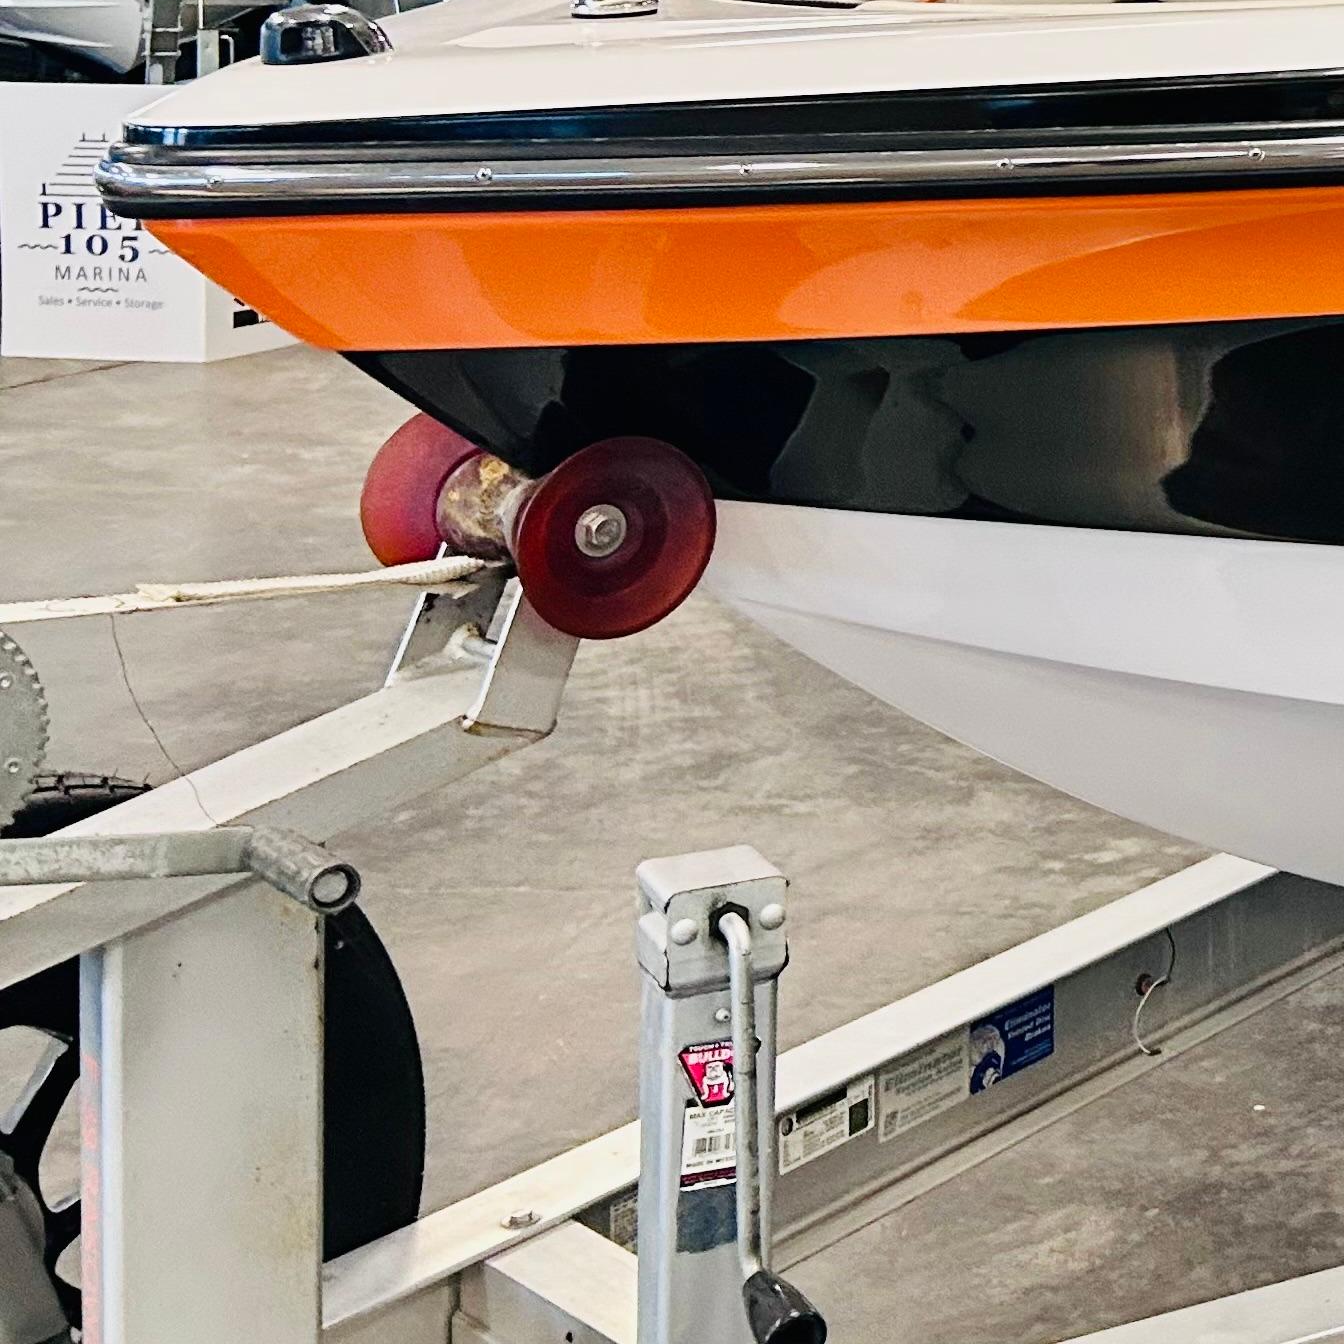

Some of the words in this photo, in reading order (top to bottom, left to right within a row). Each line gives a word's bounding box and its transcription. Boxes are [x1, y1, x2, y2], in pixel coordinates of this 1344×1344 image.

[60, 234, 140, 263] 105
[54, 265, 148, 282] MARINA
[75, 298, 113, 307] Service
[687, 1048, 732, 1065] BULLD
